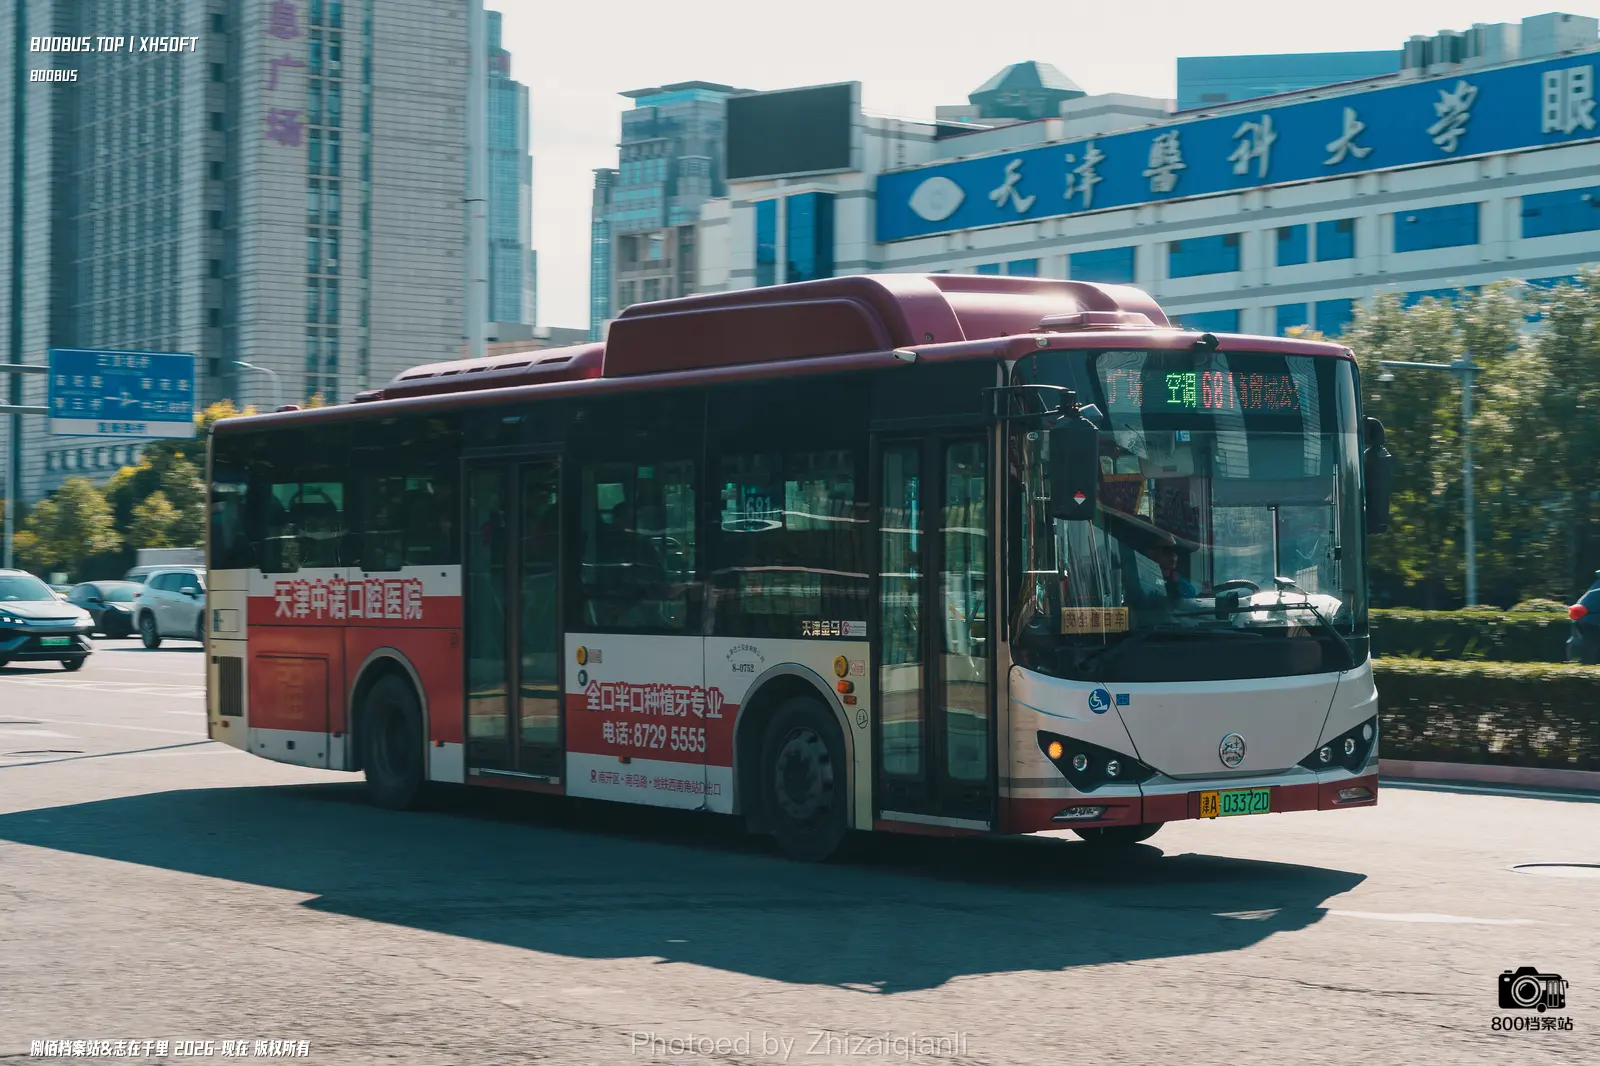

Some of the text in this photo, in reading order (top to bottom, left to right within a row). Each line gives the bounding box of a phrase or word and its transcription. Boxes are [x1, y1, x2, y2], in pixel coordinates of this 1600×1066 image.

[1202, 371, 1234, 409] 681
[274, 577, 424, 620] 天津中诺口腔医院
[802, 620, 840, 636] 天津金马
[732, 664, 755, 673] 8-0752
[585, 680, 724, 719] 全口半口种植牙专业
[670, 726, 706, 753] 5555
[1201, 791, 1270, 815] 津A 03372D
